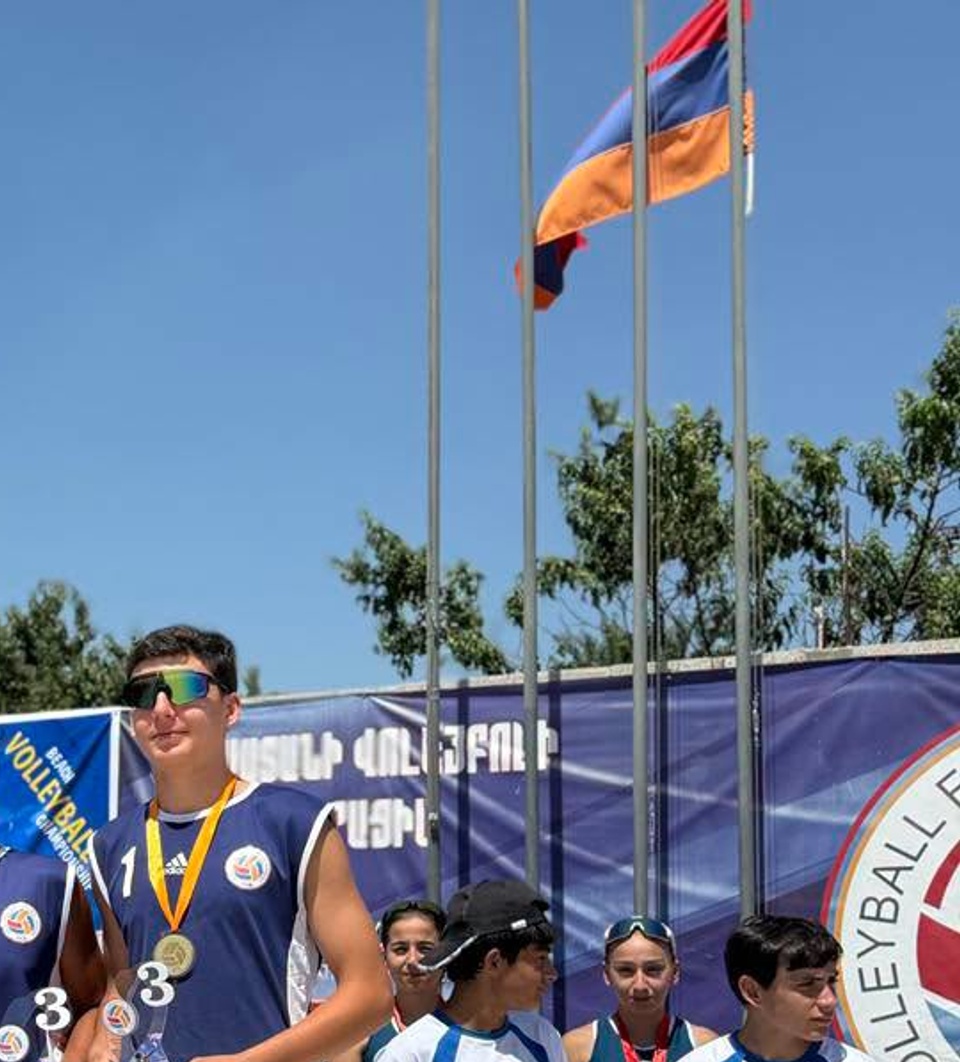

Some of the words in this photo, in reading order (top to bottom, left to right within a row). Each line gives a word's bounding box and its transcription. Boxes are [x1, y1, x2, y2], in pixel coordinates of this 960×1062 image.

[121, 846, 136, 899] 1
[137, 961, 175, 1007] 3
[34, 986, 71, 1031] 3
